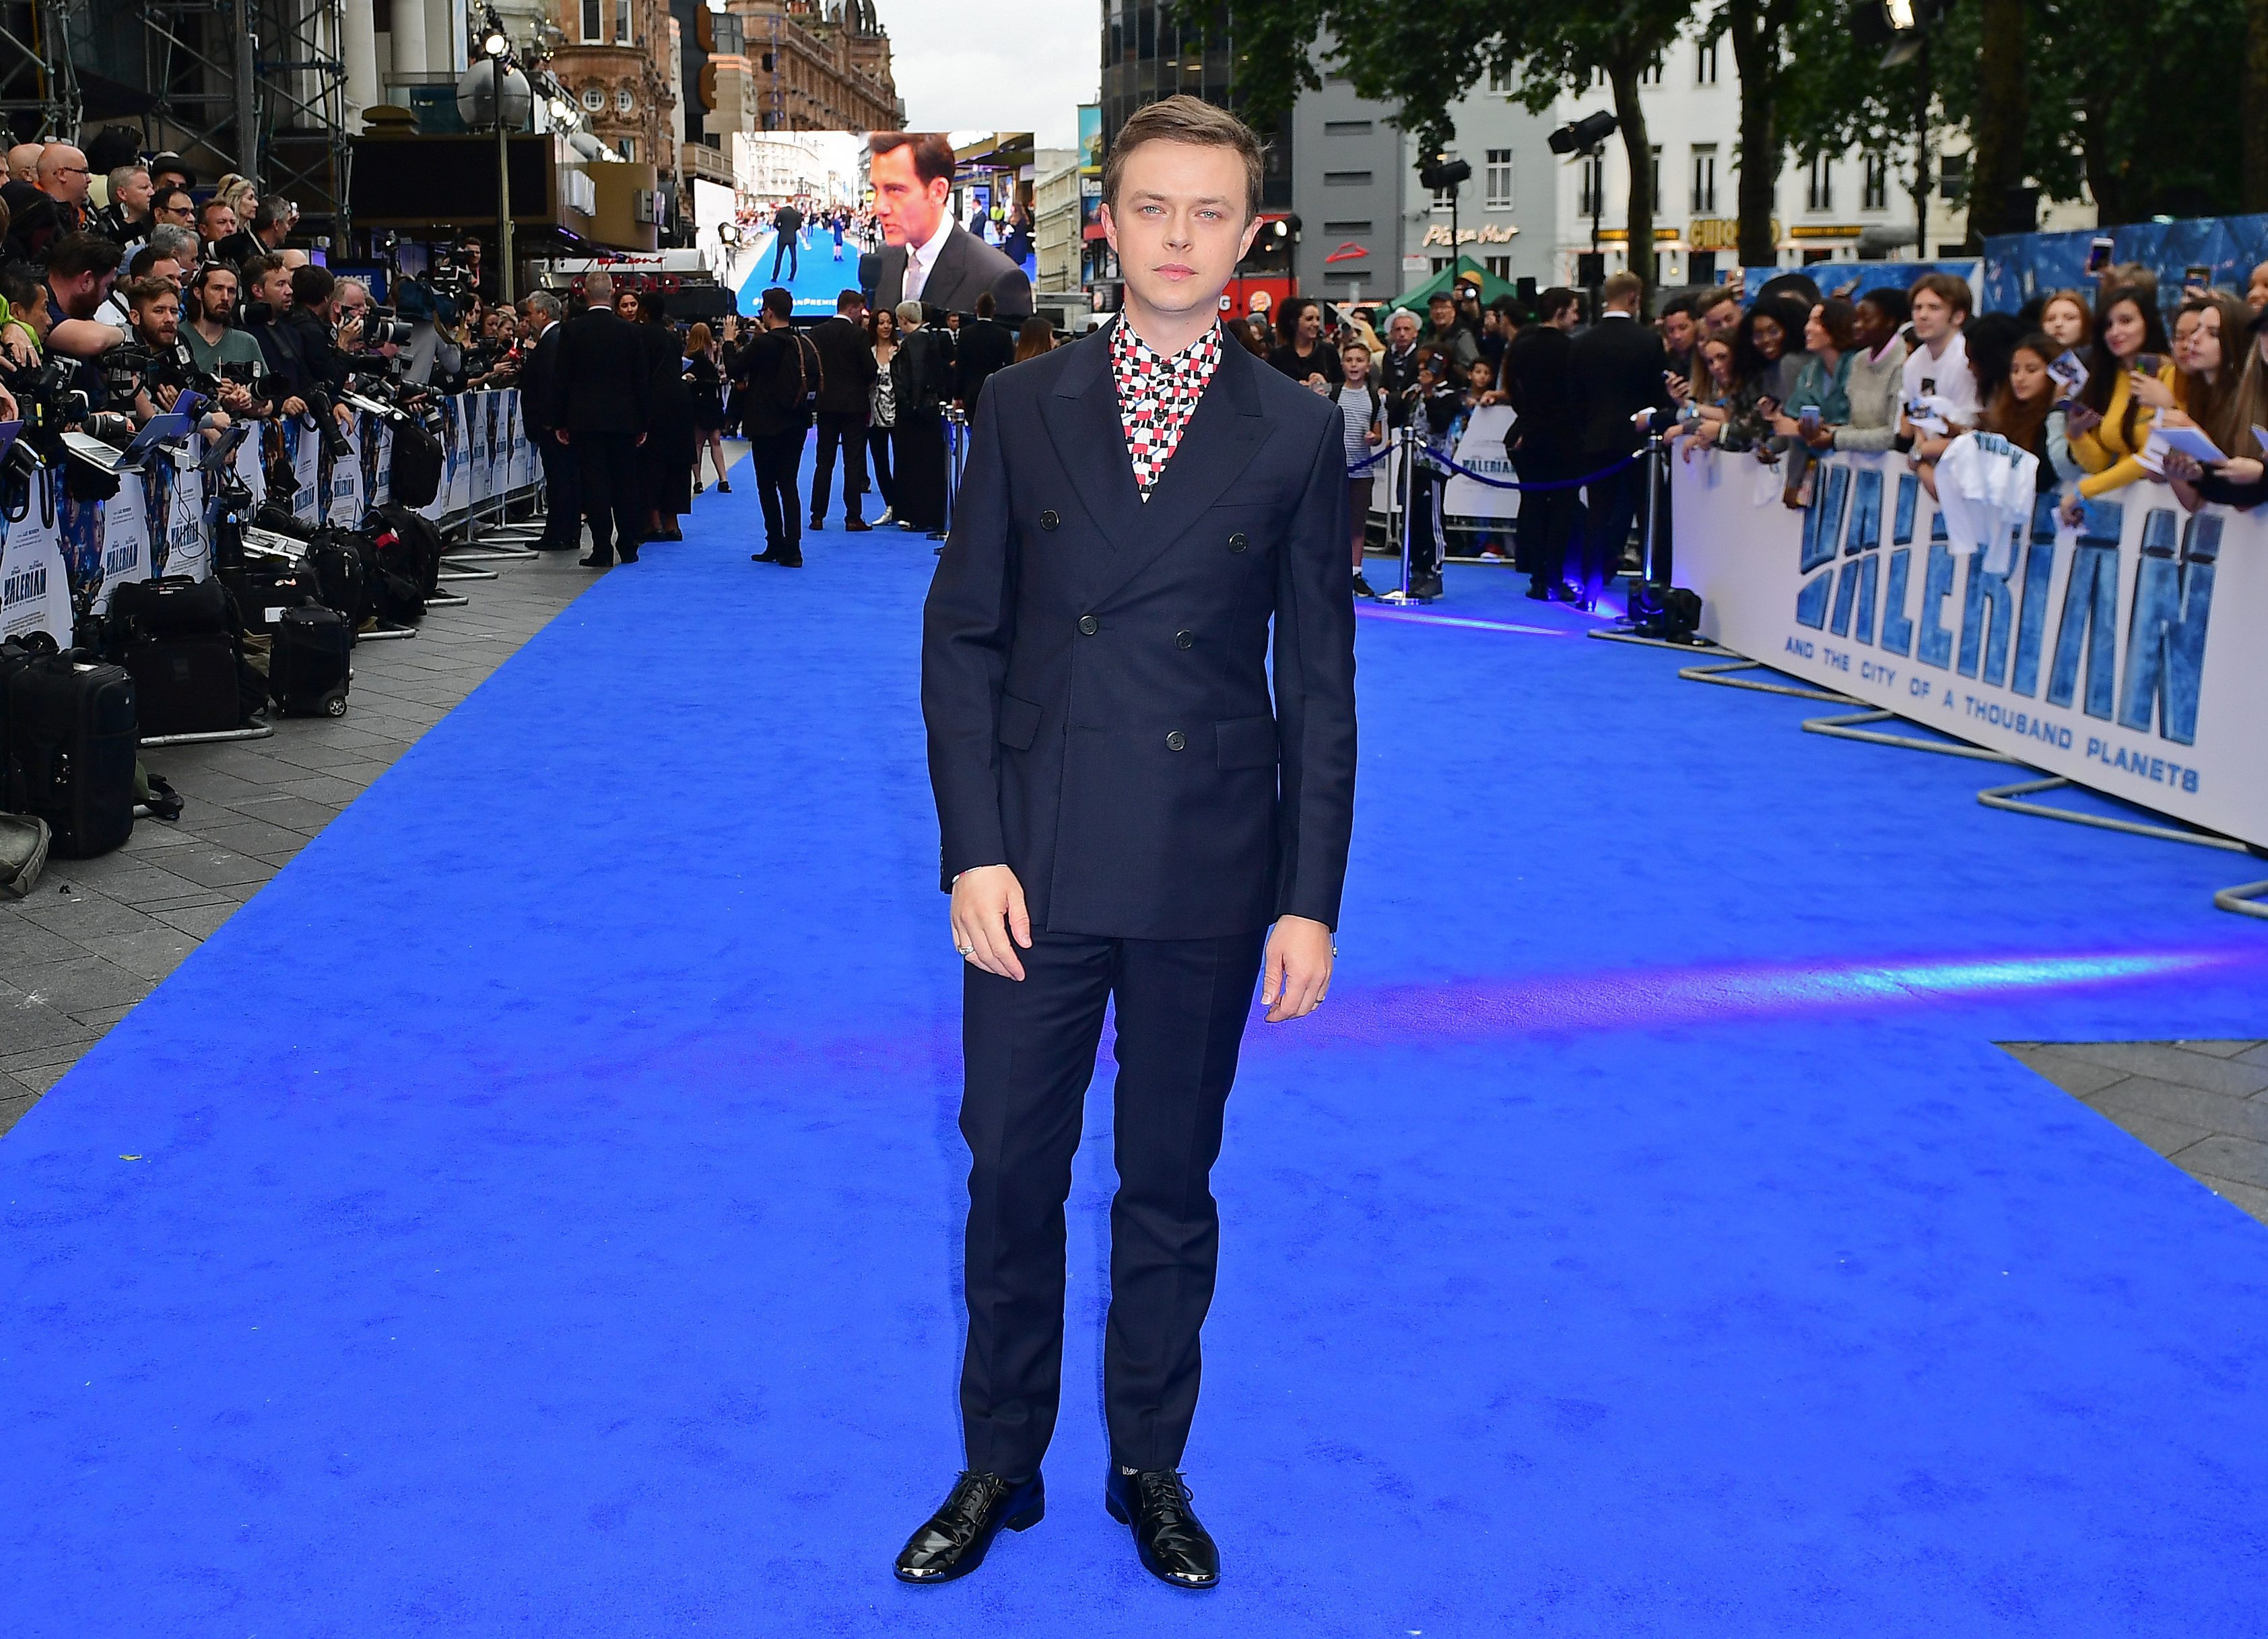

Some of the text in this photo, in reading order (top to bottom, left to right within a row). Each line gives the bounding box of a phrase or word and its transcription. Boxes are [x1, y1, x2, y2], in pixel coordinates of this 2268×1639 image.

[570, 272, 680, 294] CSINO
[4, 568, 46, 606] VALERIAN
[1796, 463, 2225, 746] VALERIAN
[1785, 636, 2199, 794] AND THE CITY OF A THOUSAND PLANETS
